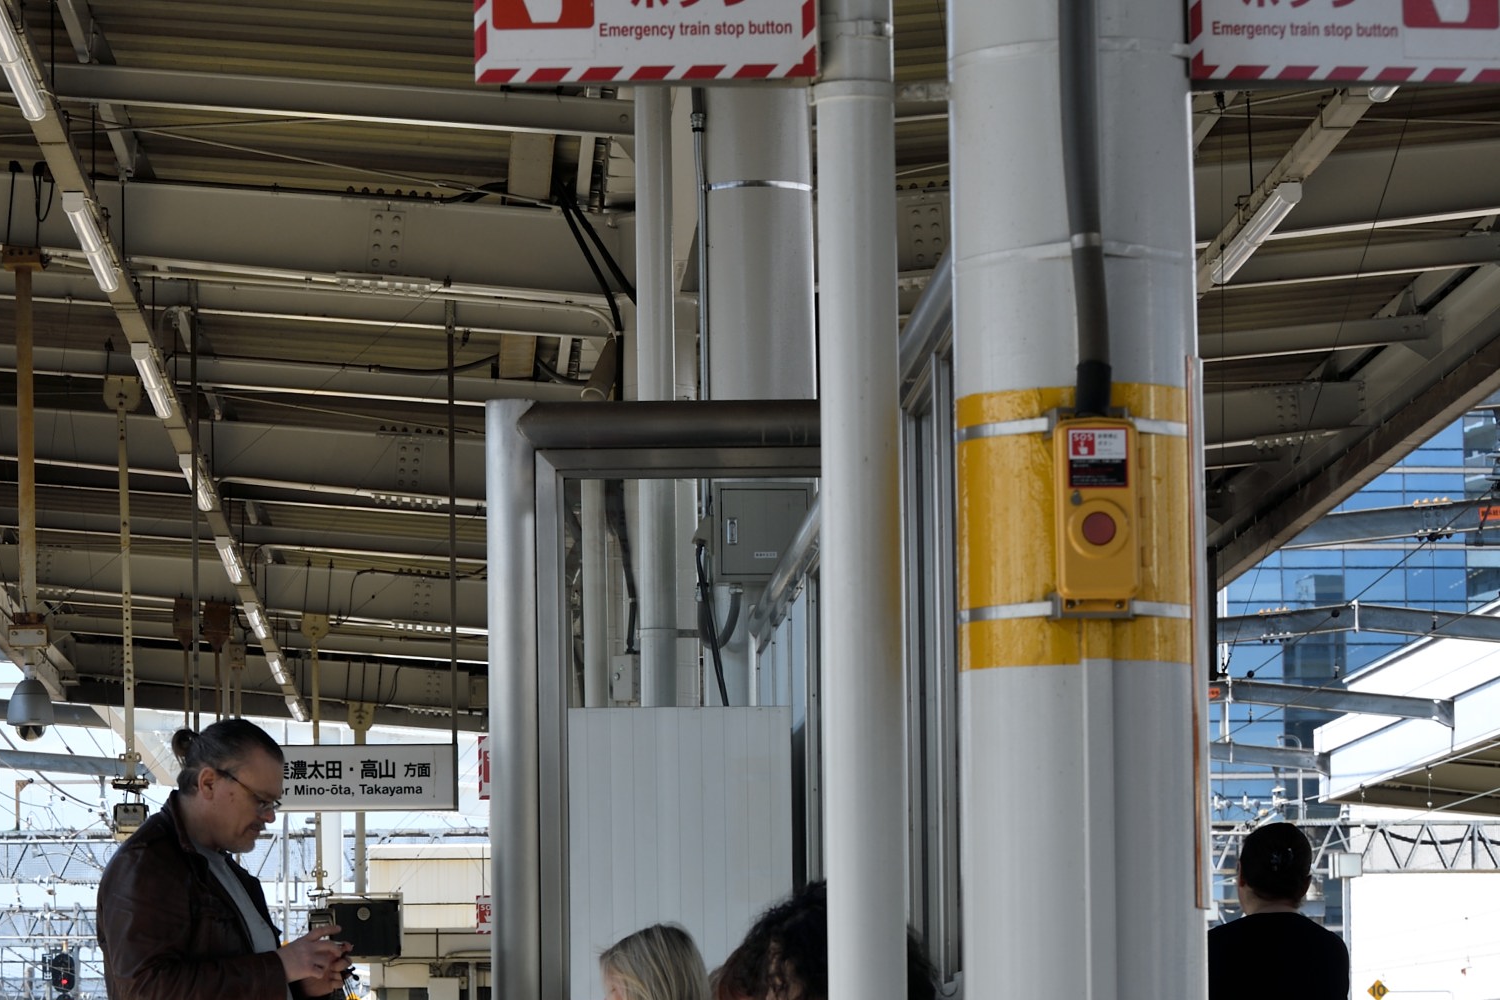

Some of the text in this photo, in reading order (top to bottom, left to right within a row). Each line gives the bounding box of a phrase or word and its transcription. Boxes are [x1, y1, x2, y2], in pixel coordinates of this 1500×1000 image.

[599, 20, 793, 39] Emergency train stop button
[1211, 21, 1398, 40] Emergency train stop button
[1073, 433, 1093, 441] SOS
[404, 762, 431, 778] 方面
[294, 784, 354, 797] Mino-ōta,
[359, 784, 423, 797] Takayama
[1371, 984, 1386, 997] 10
